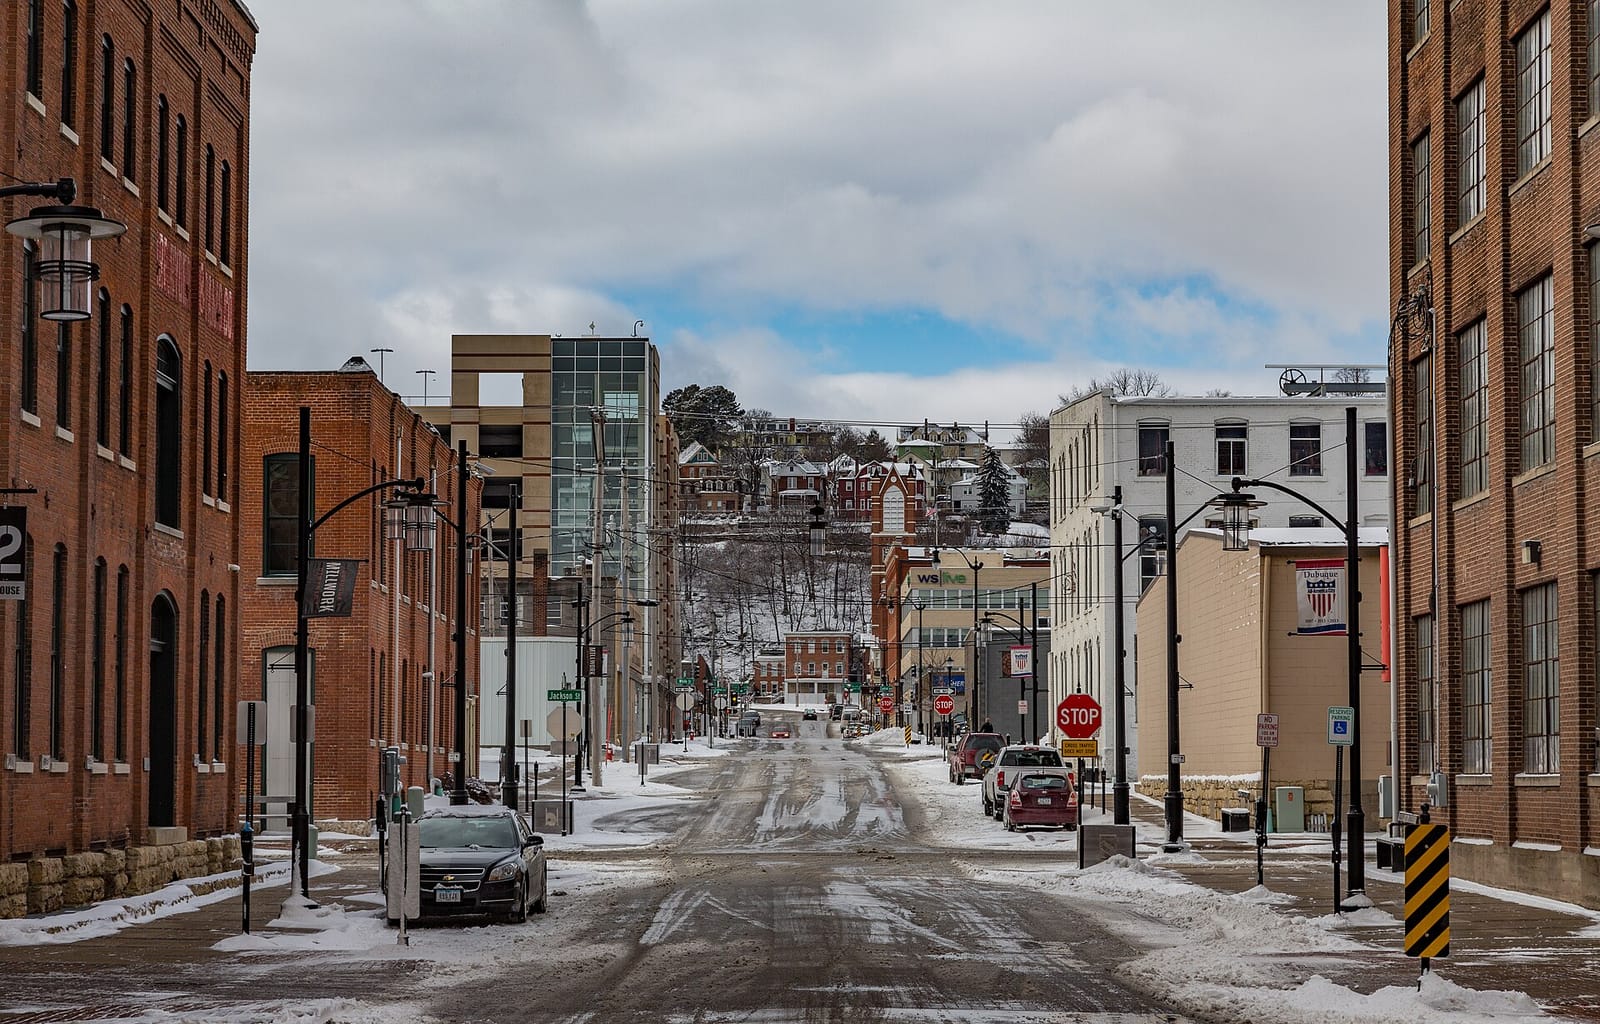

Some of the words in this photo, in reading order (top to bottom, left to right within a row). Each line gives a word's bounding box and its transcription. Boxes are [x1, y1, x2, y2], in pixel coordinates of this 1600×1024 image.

[0, 525, 22, 573] 2
[917, 574, 939, 583] ws
[942, 571, 966, 583] live
[1303, 571, 1338, 579] Dubuque
[318, 562, 341, 612] MILLWORK
[549, 692, 573, 700] Jackson
[575, 692, 581, 700] St
[935, 700, 953, 709] STOP
[1060, 708, 1099, 725] STOP
[1263, 716, 1273, 724] NO
